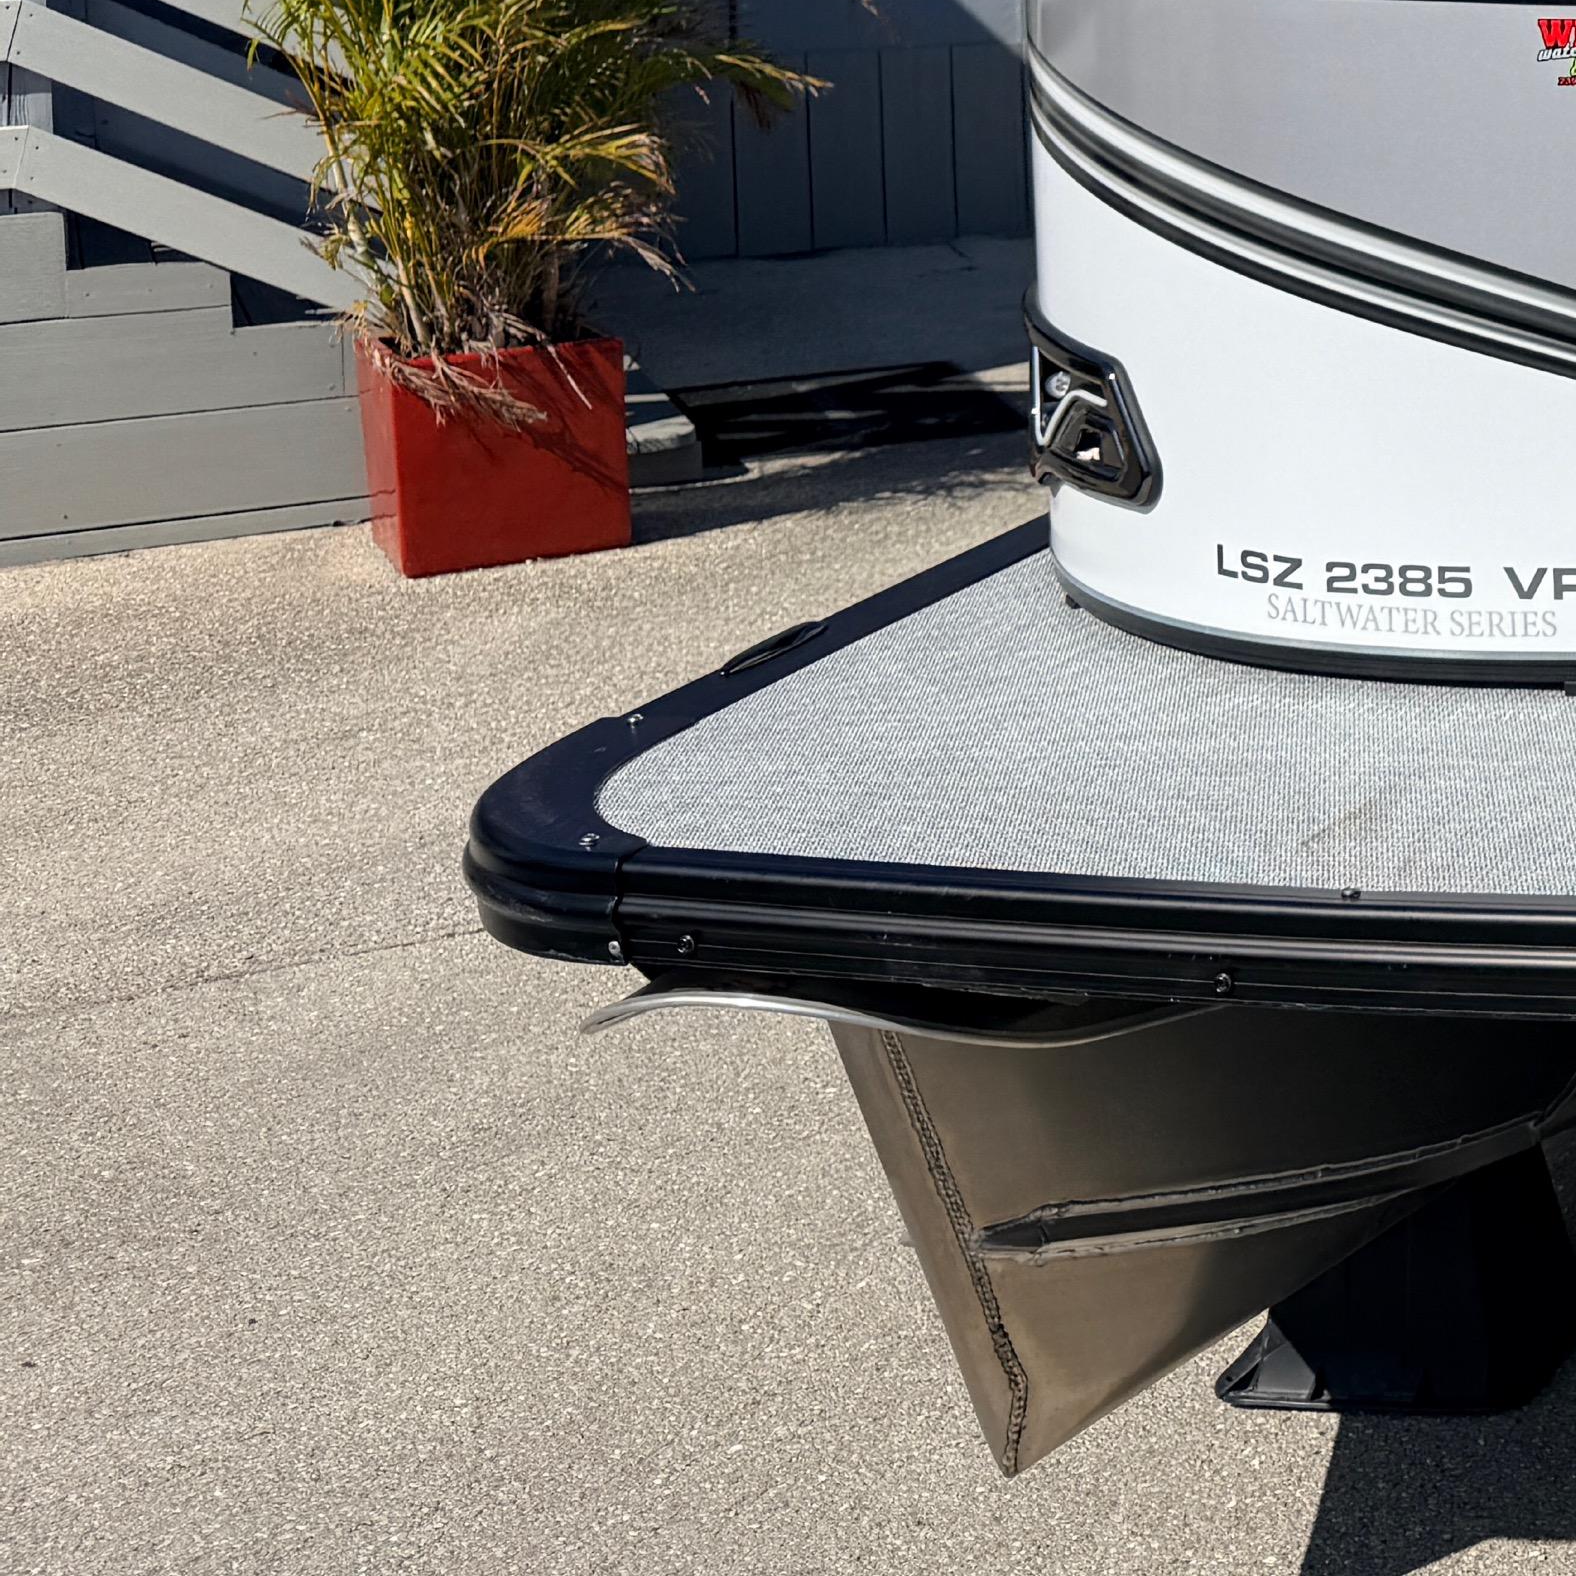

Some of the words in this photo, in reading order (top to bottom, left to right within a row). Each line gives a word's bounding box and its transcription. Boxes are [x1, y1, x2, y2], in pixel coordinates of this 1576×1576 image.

[1216, 543, 1304, 590] LSZ
[1324, 560, 1474, 600] 2385
[1266, 592, 1441, 637] SALTWATER
[1449, 609, 1558, 639] SERIES
